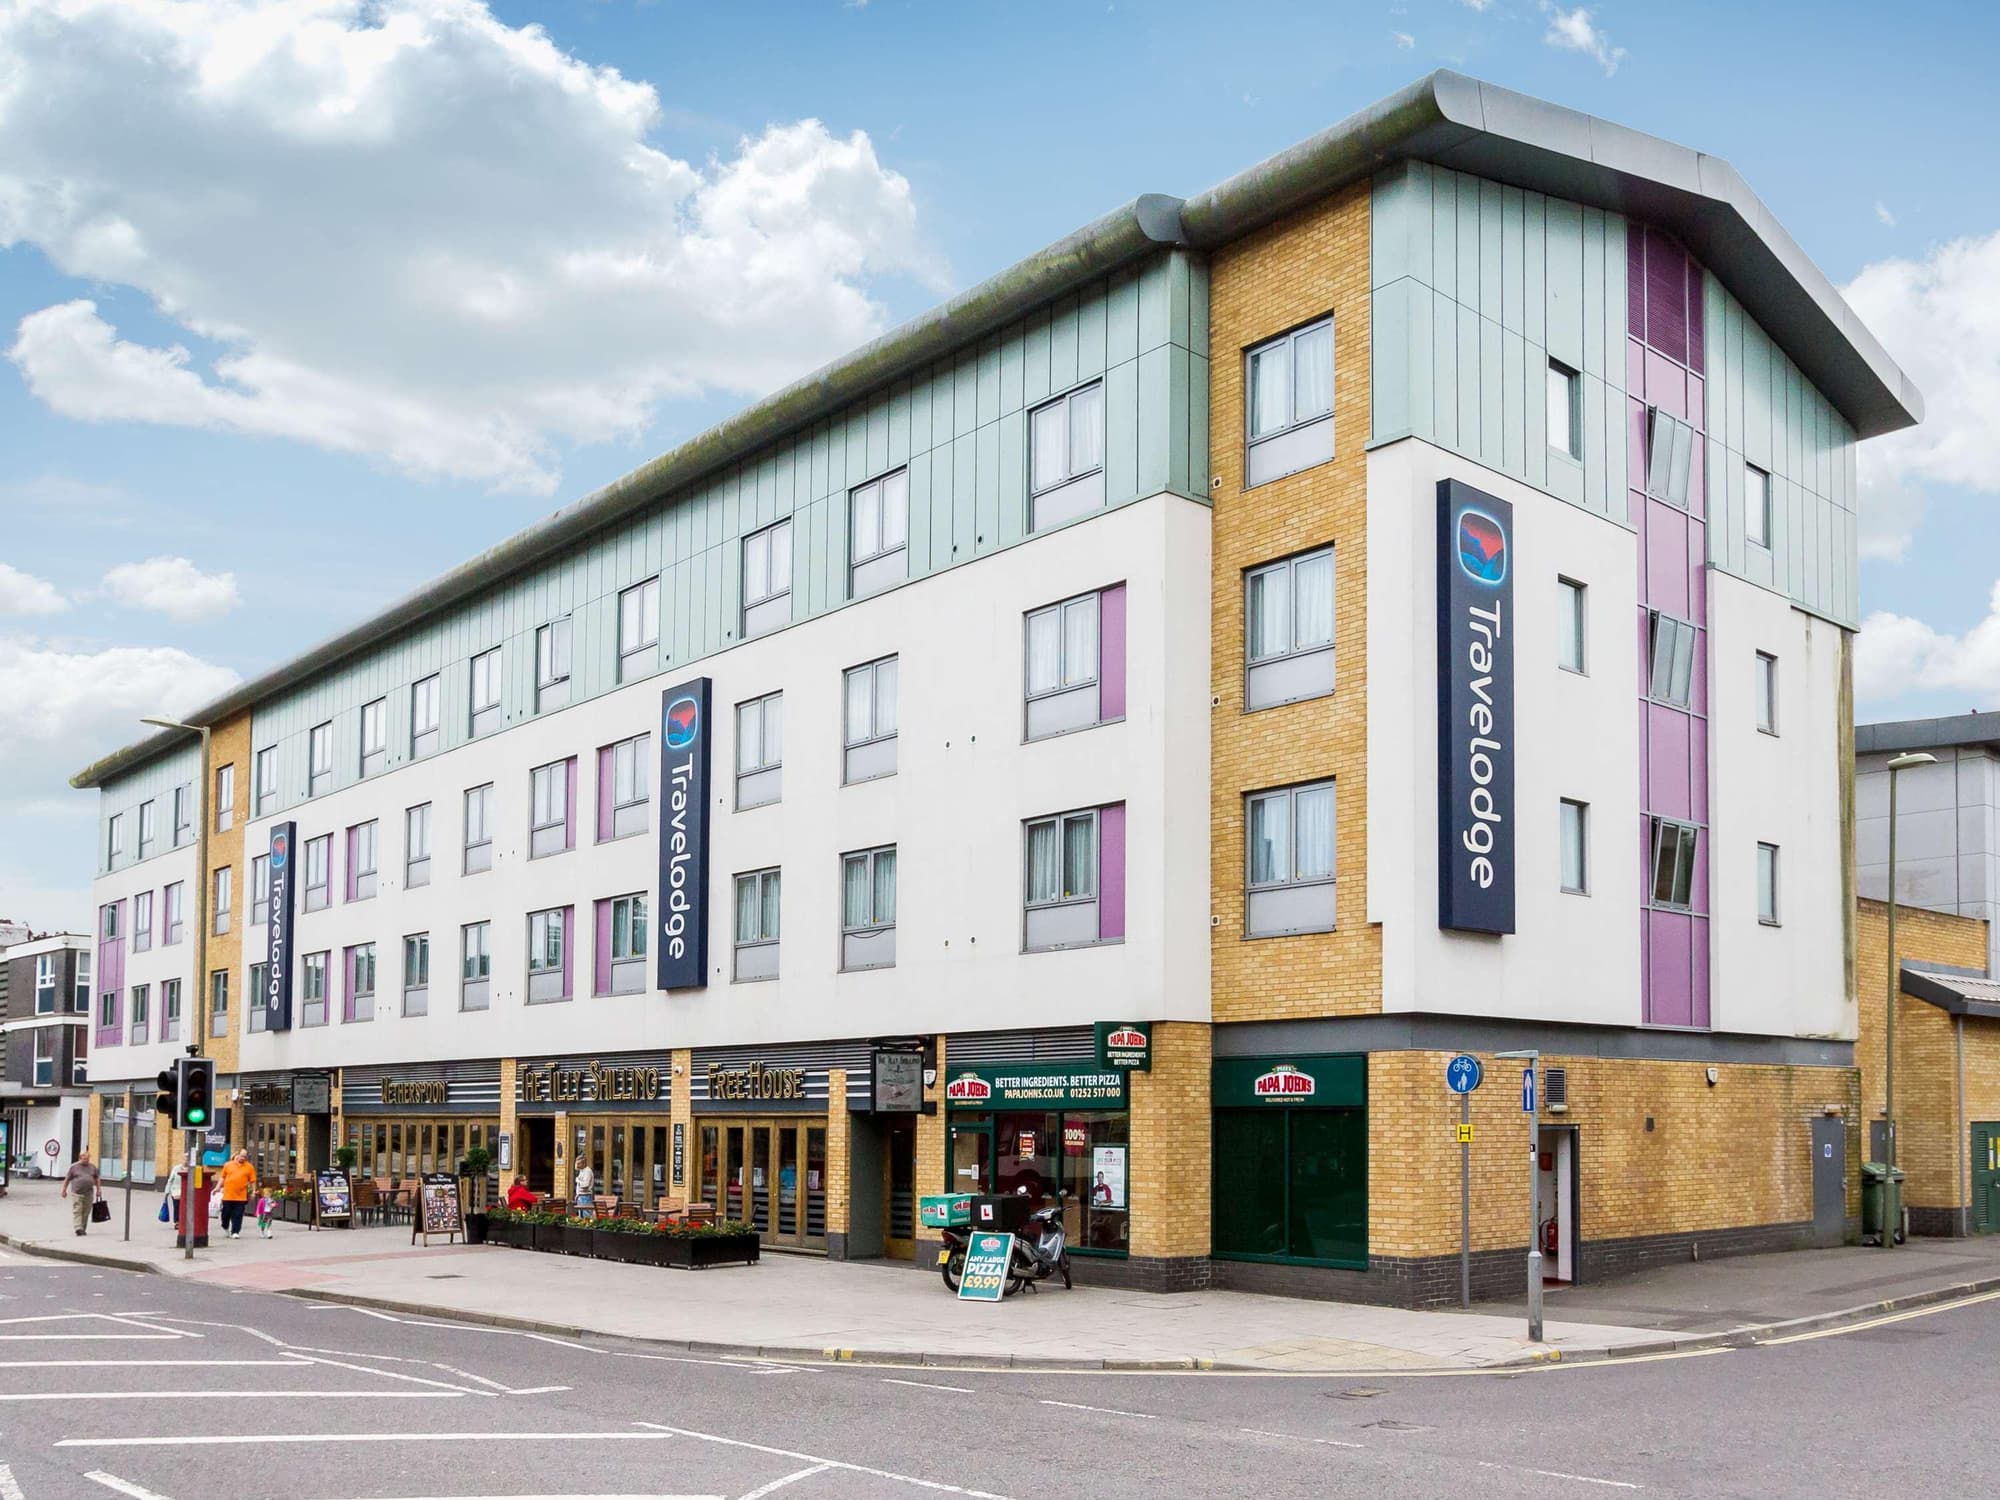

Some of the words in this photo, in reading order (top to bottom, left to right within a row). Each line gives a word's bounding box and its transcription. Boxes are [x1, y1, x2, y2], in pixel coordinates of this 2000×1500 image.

[1462, 600, 1502, 889] Travelodge
[664, 752, 694, 960] Travelodge
[269, 872, 285, 1011] Travelodge
[1110, 1033, 1125, 1045] PAPA
[517, 1063, 545, 1101] THE
[545, 1061, 585, 1101] TILLY
[589, 1059, 660, 1101] SHILLING
[708, 1062, 748, 1099] FREE
[748, 1060, 806, 1099] HOUSE
[995, 1077, 1021, 1088] BETTER
[1021, 1075, 1069, 1088] INGREDIENTS.
[1070, 1075, 1099, 1087] BETTER
[1100, 1074, 1120, 1086] PIZZA
[1257, 1075, 1280, 1093] PAPA
[1282, 1074, 1312, 1093] JOHNS
[381, 1076, 448, 1104] WETHERSPOON
[949, 1081, 966, 1097] PAPA
[967, 1080, 989, 1097] JOHNS
[1004, 1088, 1064, 1099] PAPAJOHNS.CO.UK
[1070, 1088, 1092, 1098] 01252
[1093, 1088, 1106, 1098] 517
[1107, 1087, 1121, 1098] 000
[1064, 1129, 1086, 1140] 100%
[1459, 1126, 1471, 1140] H
[939, 1207, 945, 1216] L
[983, 1208, 989, 1217] L
[967, 1263, 1002, 1275] PIZZA
[964, 1276, 1000, 1288] £9.99
